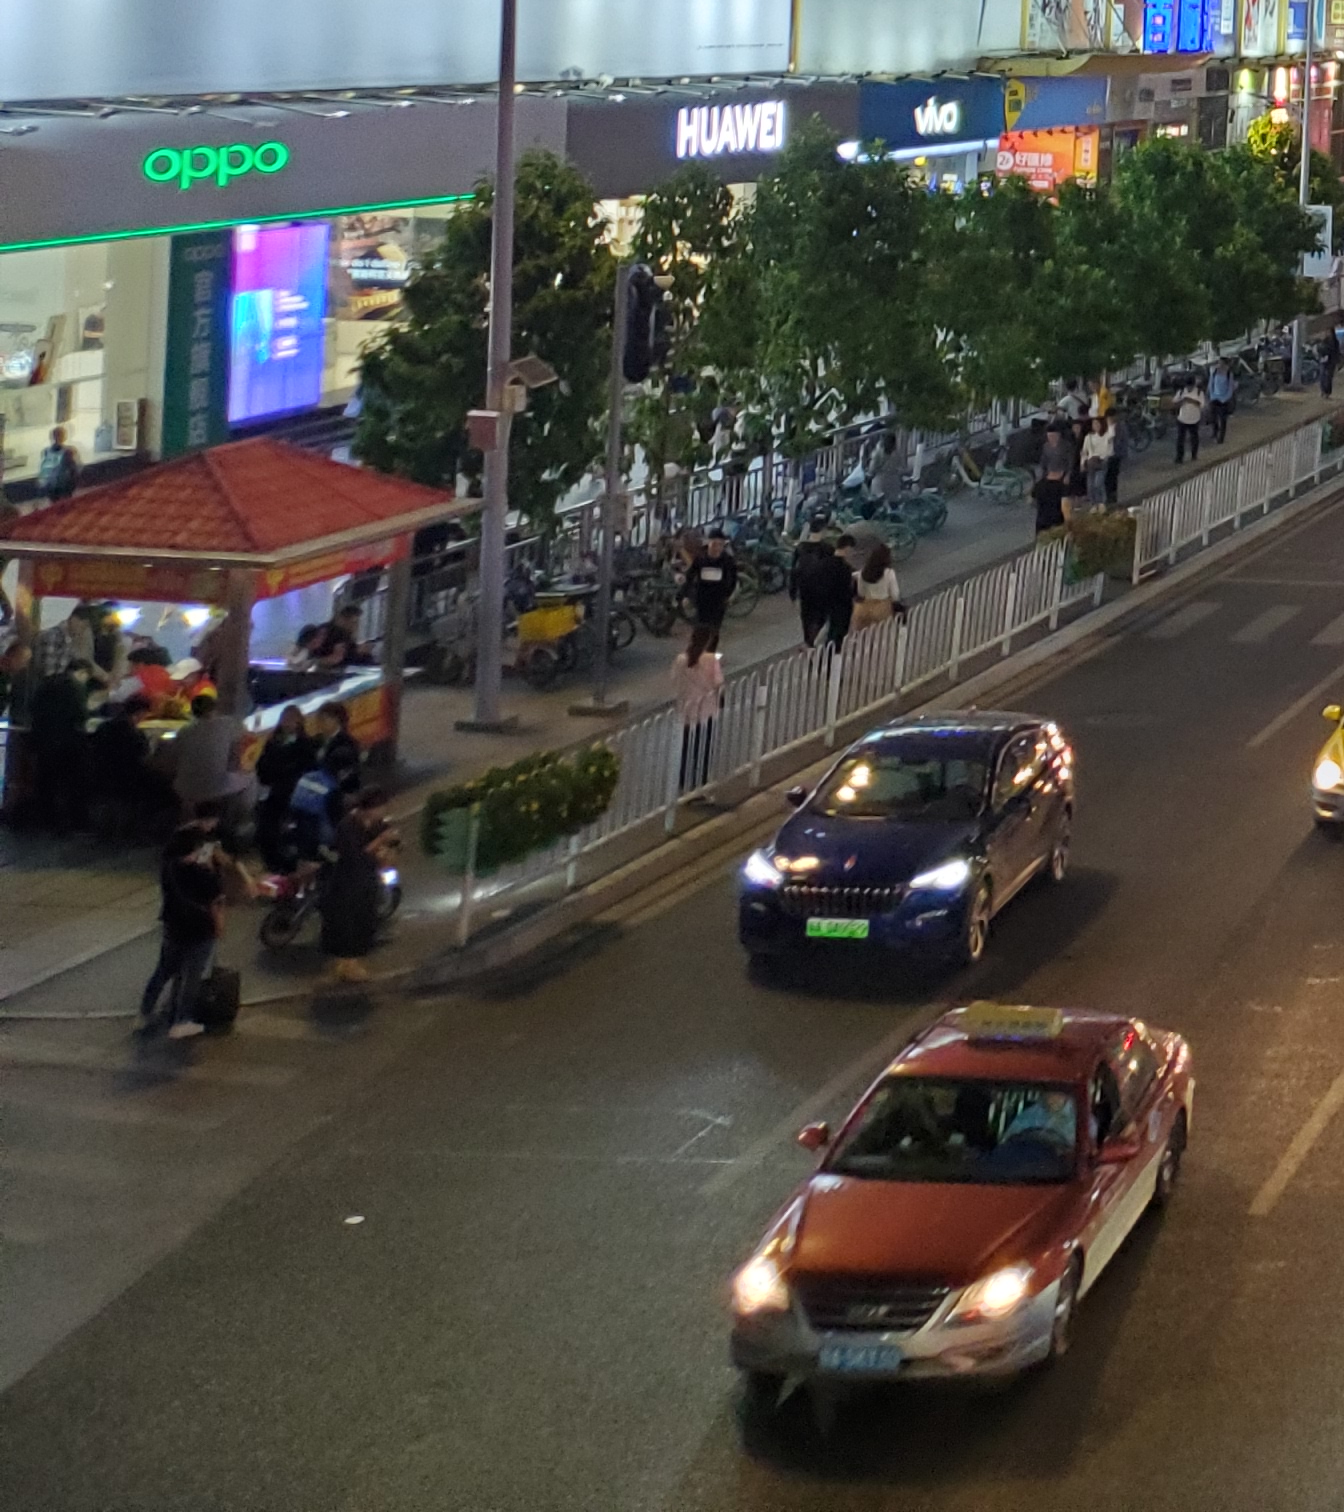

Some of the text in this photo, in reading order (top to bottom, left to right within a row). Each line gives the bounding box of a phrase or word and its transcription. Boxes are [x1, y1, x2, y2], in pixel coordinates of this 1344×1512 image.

[678, 99, 784, 158] HUAWEI
[914, 95, 959, 135] vivo
[144, 141, 289, 189] oppo
